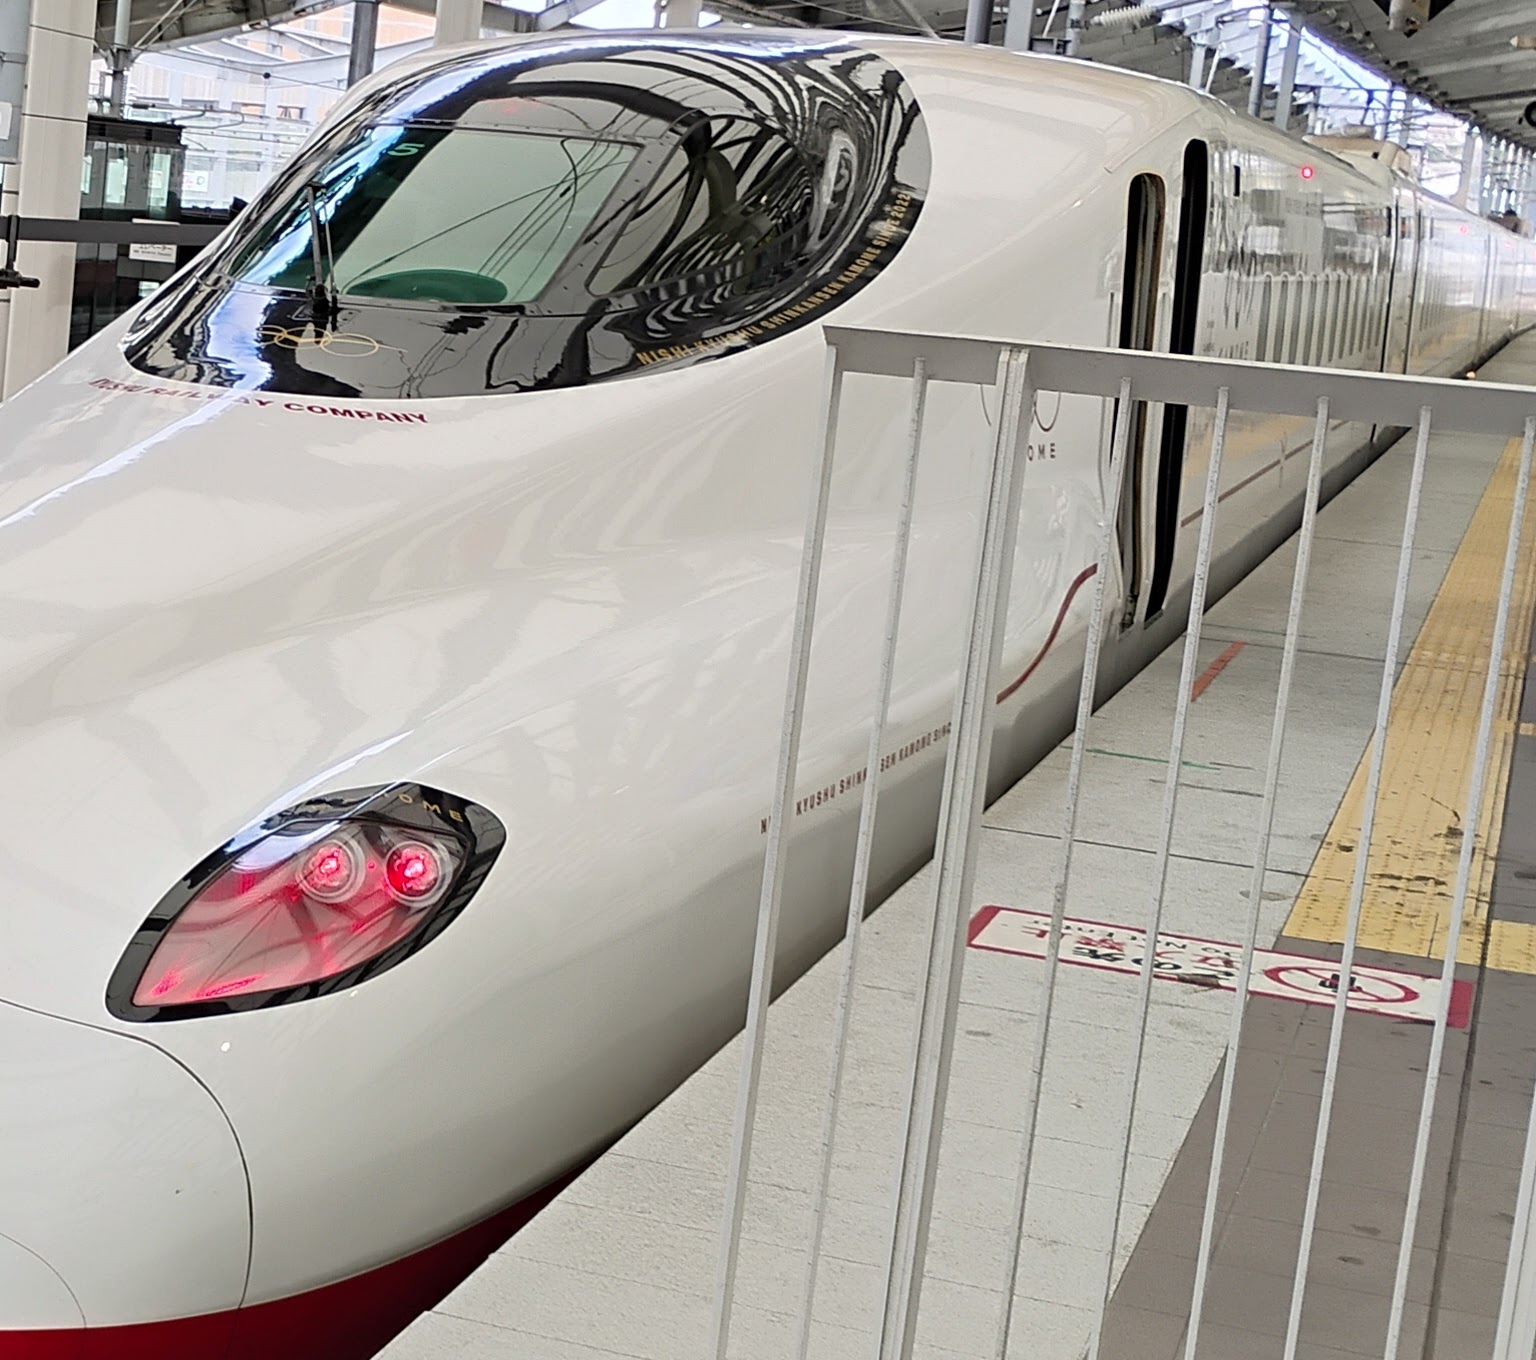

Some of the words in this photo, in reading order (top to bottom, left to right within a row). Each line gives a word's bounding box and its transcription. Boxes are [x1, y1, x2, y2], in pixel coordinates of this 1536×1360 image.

[387, 142, 426, 157] 5
[760, 281, 845, 330] SHINKANSEN
[837, 247, 882, 285] KAMOME
[890, 192, 912, 220] 2022
[284, 402, 427, 424] COMPANY
